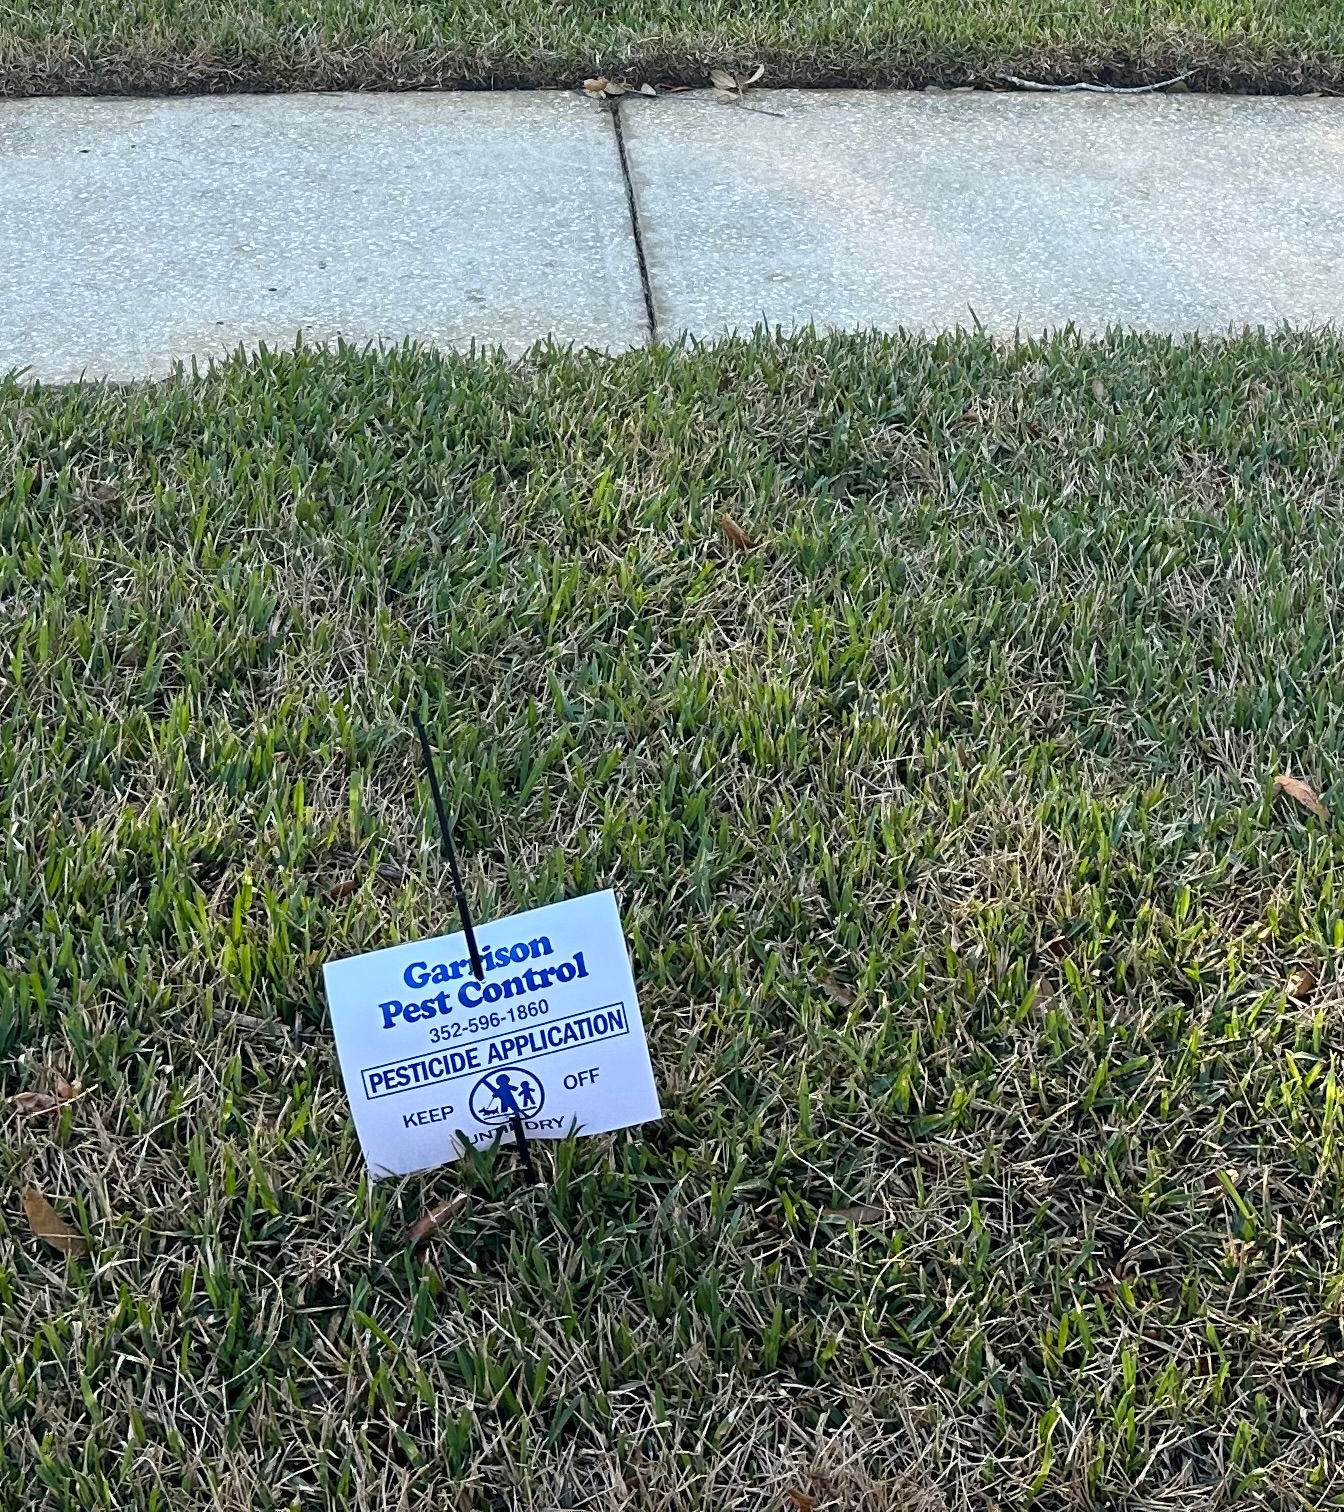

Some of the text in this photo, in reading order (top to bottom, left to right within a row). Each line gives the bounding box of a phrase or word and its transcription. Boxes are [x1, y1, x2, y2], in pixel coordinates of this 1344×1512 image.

[378, 952, 589, 1029] Pest Control
[429, 999, 549, 1043] 352-596-1860
[367, 1009, 624, 1094] PESTICIDE APPLICATION
[402, 1067, 600, 1129] KEEP OFF
[526, 1116, 565, 1130] DRY
